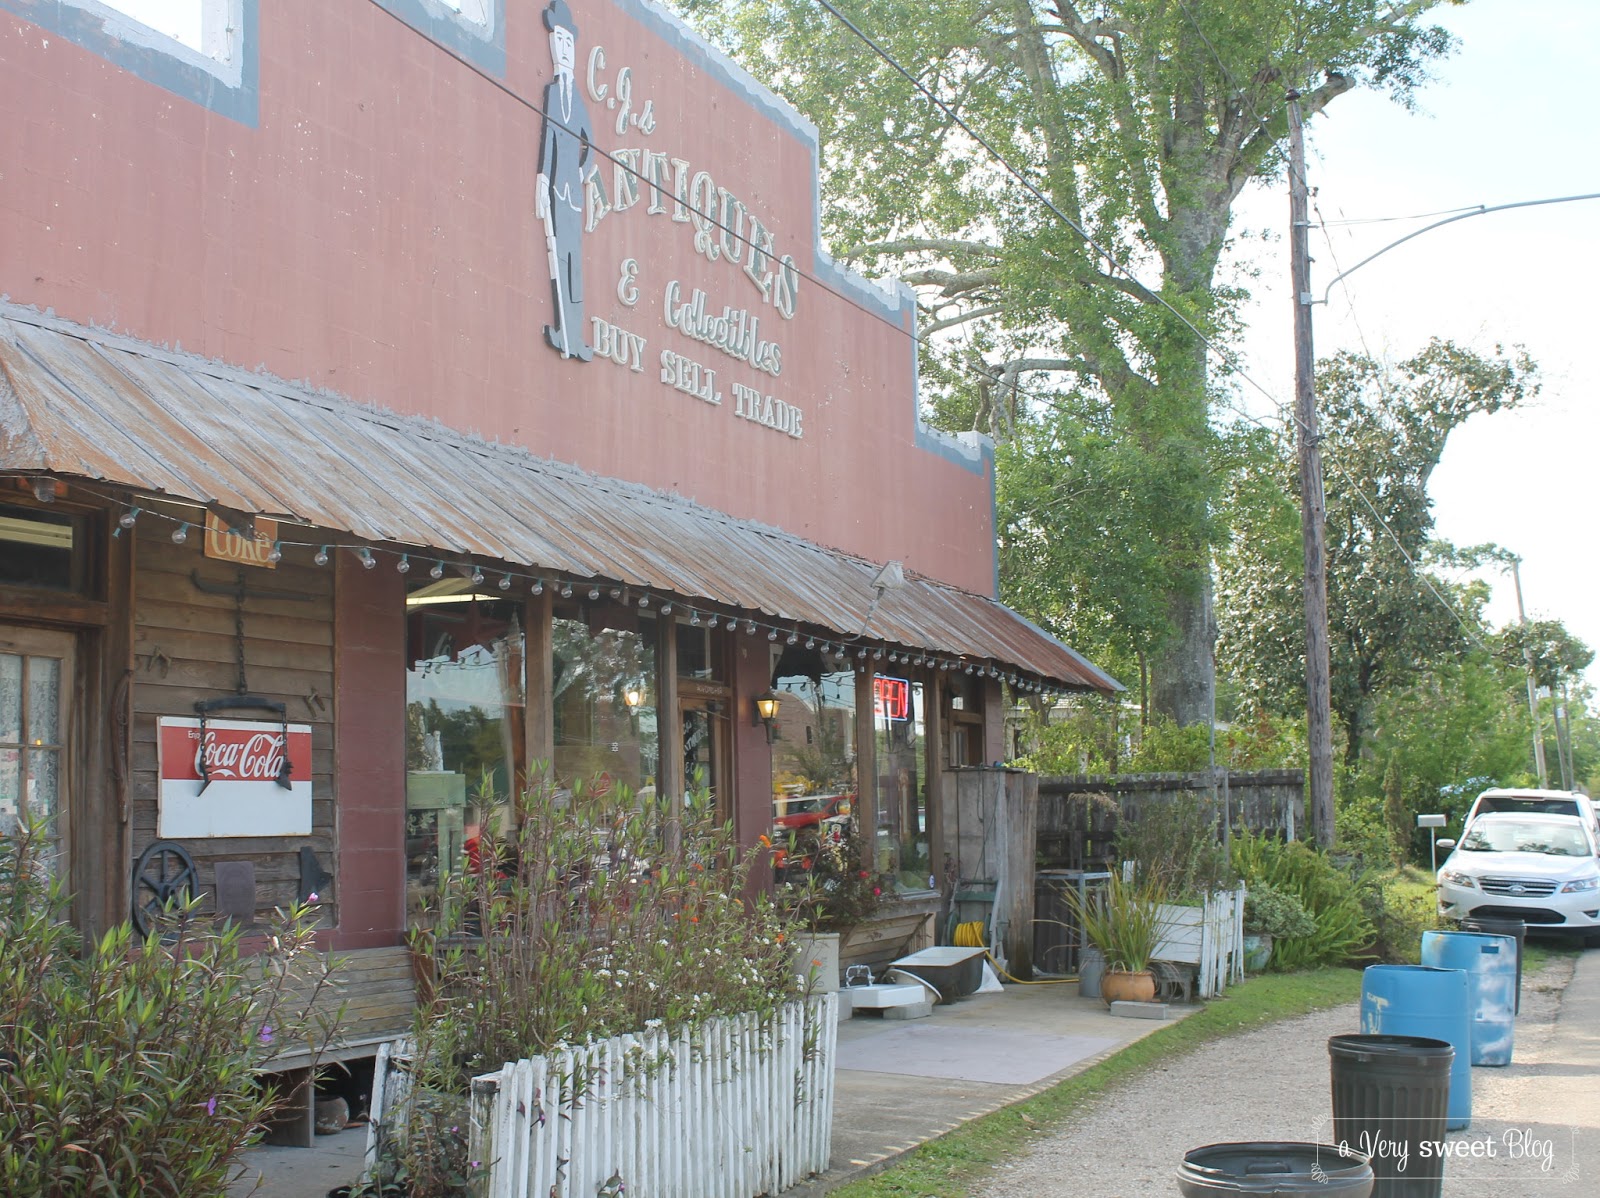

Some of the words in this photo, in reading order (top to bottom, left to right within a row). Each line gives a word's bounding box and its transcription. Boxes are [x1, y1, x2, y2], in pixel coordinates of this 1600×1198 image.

[584, 148, 800, 320] ANTIQUES
[590, 316, 647, 373] BUY
[660, 349, 722, 406] SELL
[732, 382, 803, 438] TRADE
[617, 258, 640, 306] &
[664, 280, 782, 378] Collectibles
